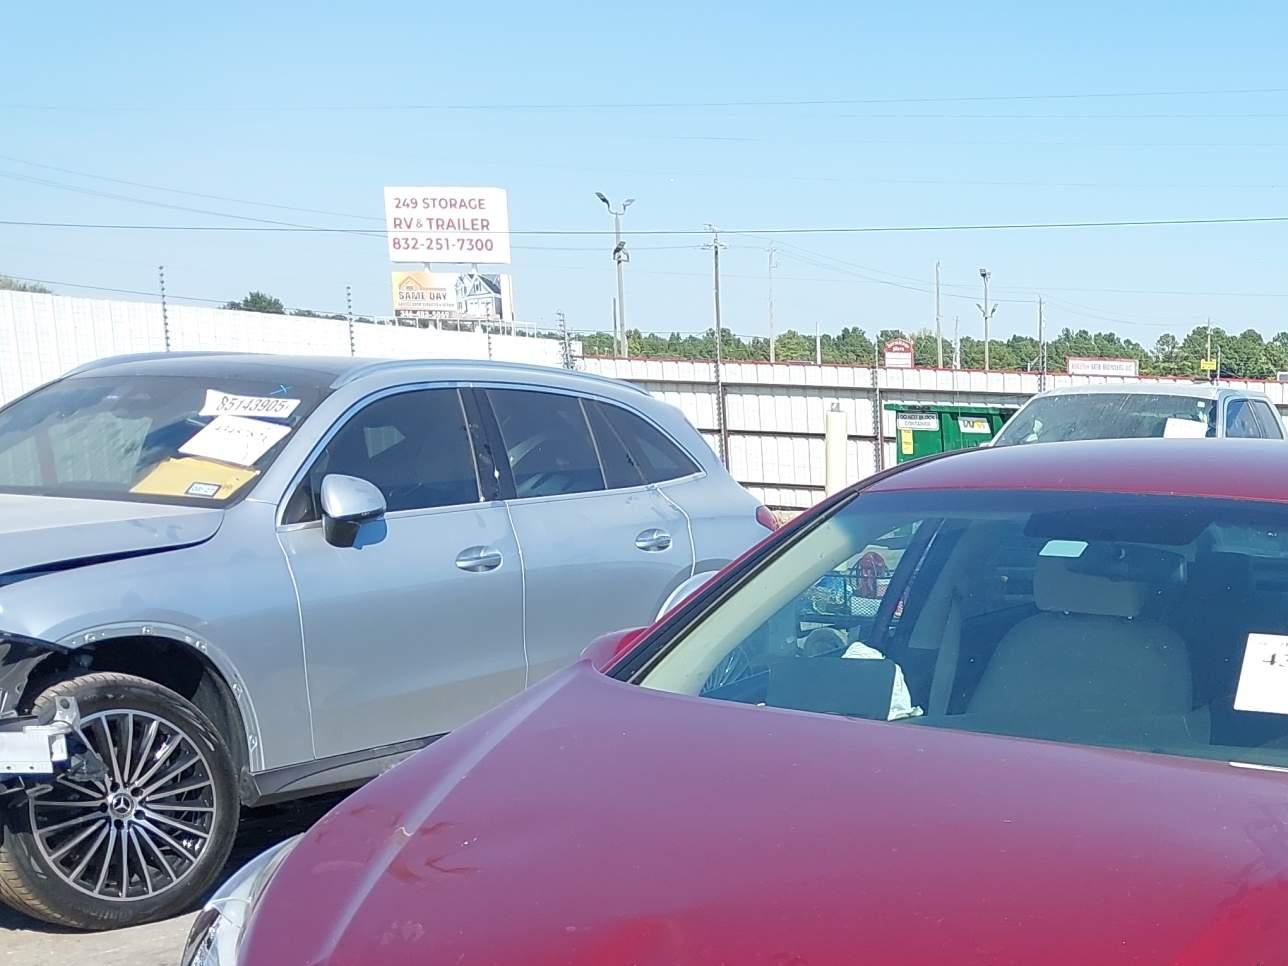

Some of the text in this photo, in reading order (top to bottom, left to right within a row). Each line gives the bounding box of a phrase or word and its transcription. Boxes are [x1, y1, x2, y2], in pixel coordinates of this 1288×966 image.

[393, 197, 486, 210] 249 STORAGE
[393, 217, 490, 231] RV & TRAILER
[392, 237, 494, 251] 832-251-7300
[398, 291, 447, 301] SAME DAY
